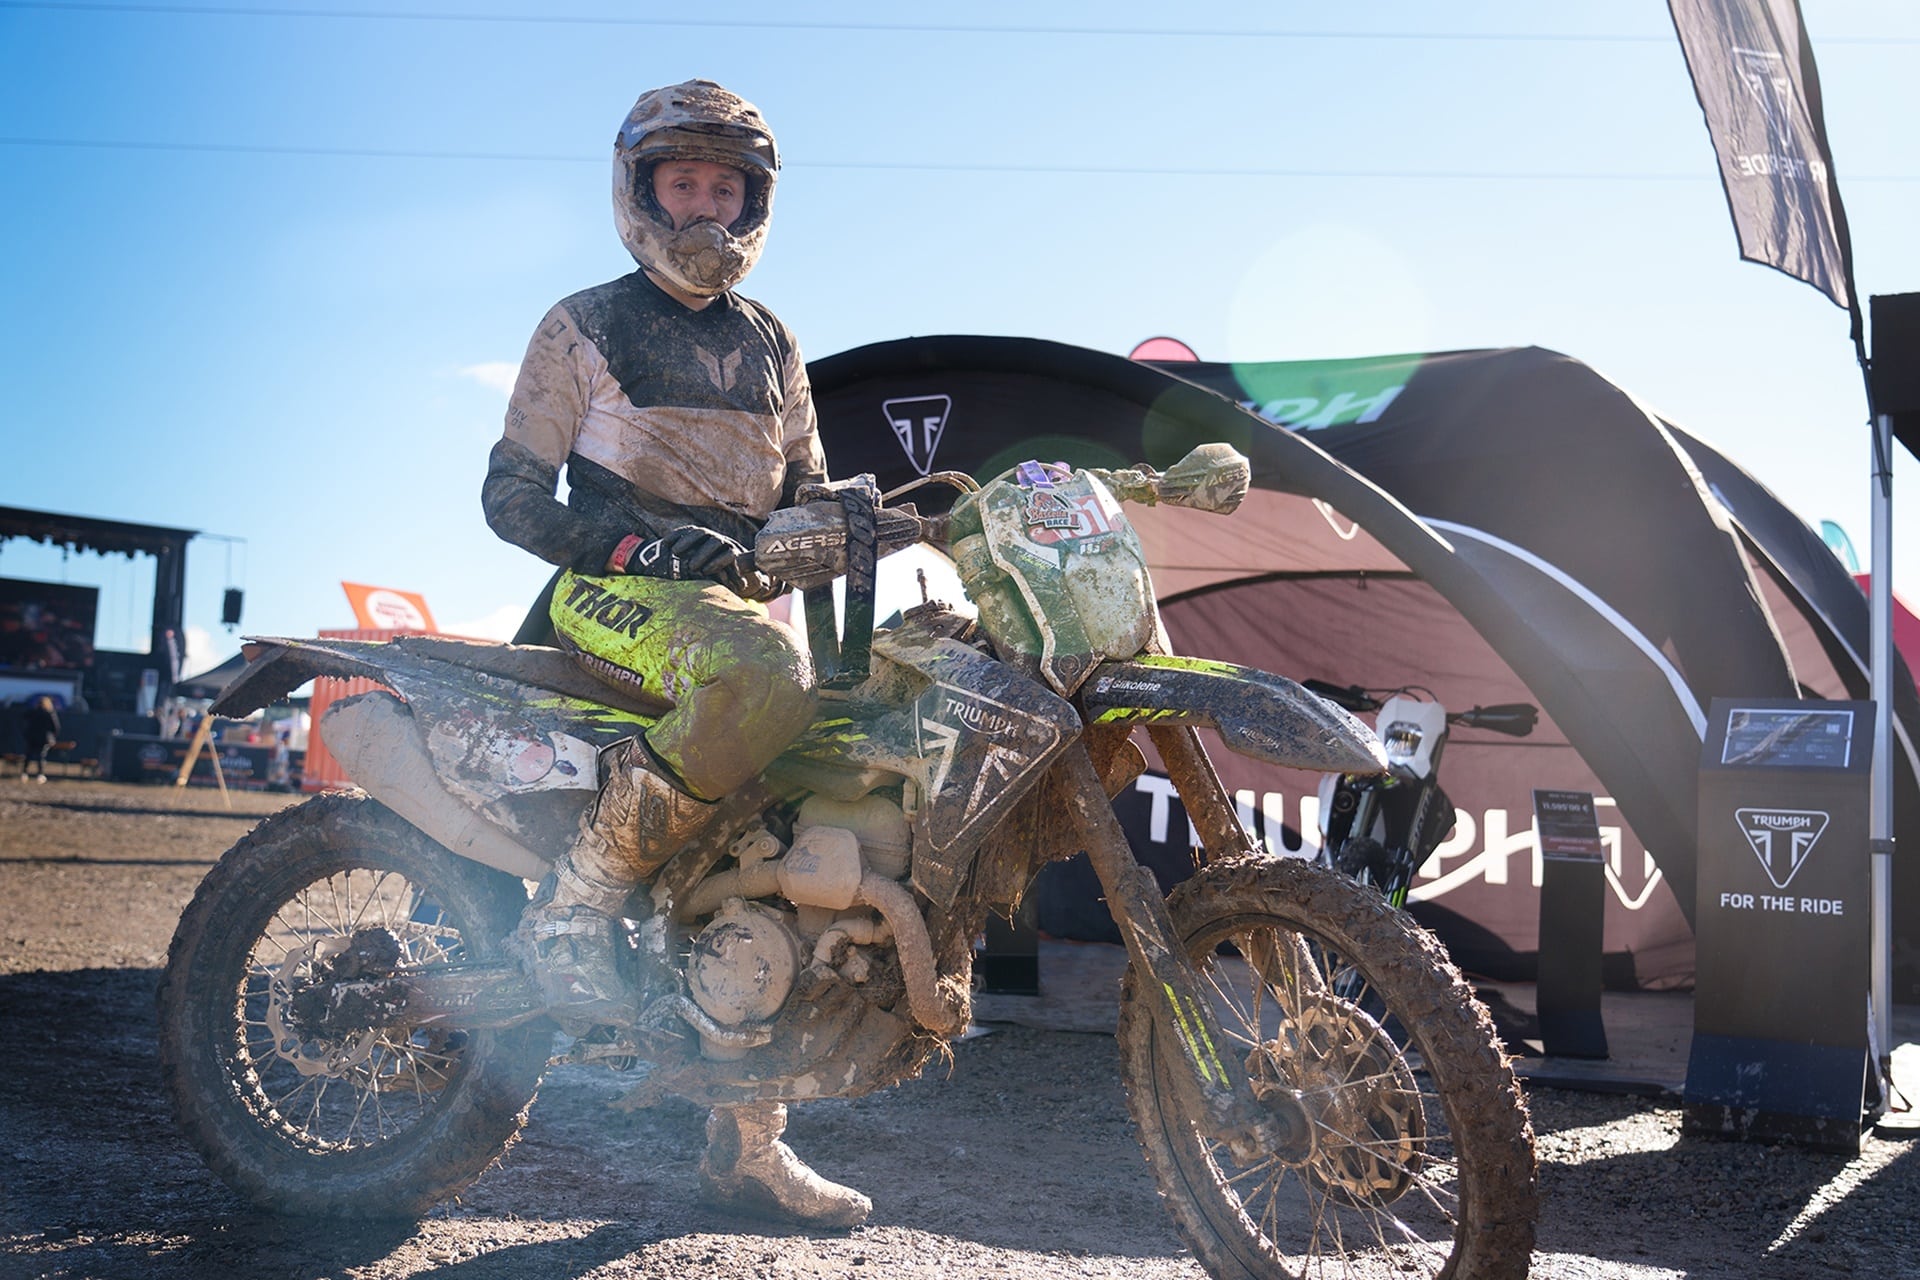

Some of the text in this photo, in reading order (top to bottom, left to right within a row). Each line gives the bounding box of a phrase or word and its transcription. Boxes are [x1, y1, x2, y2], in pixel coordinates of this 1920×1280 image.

[1046, 518, 1069, 527] RACE
[565, 577, 653, 640] THOR
[577, 650, 643, 686] TRIUMPH
[945, 698, 1020, 738] TRIUMPH
[1752, 814, 1811, 828] TRIUMPH
[1720, 893, 1843, 915] FOR THE RIDE
